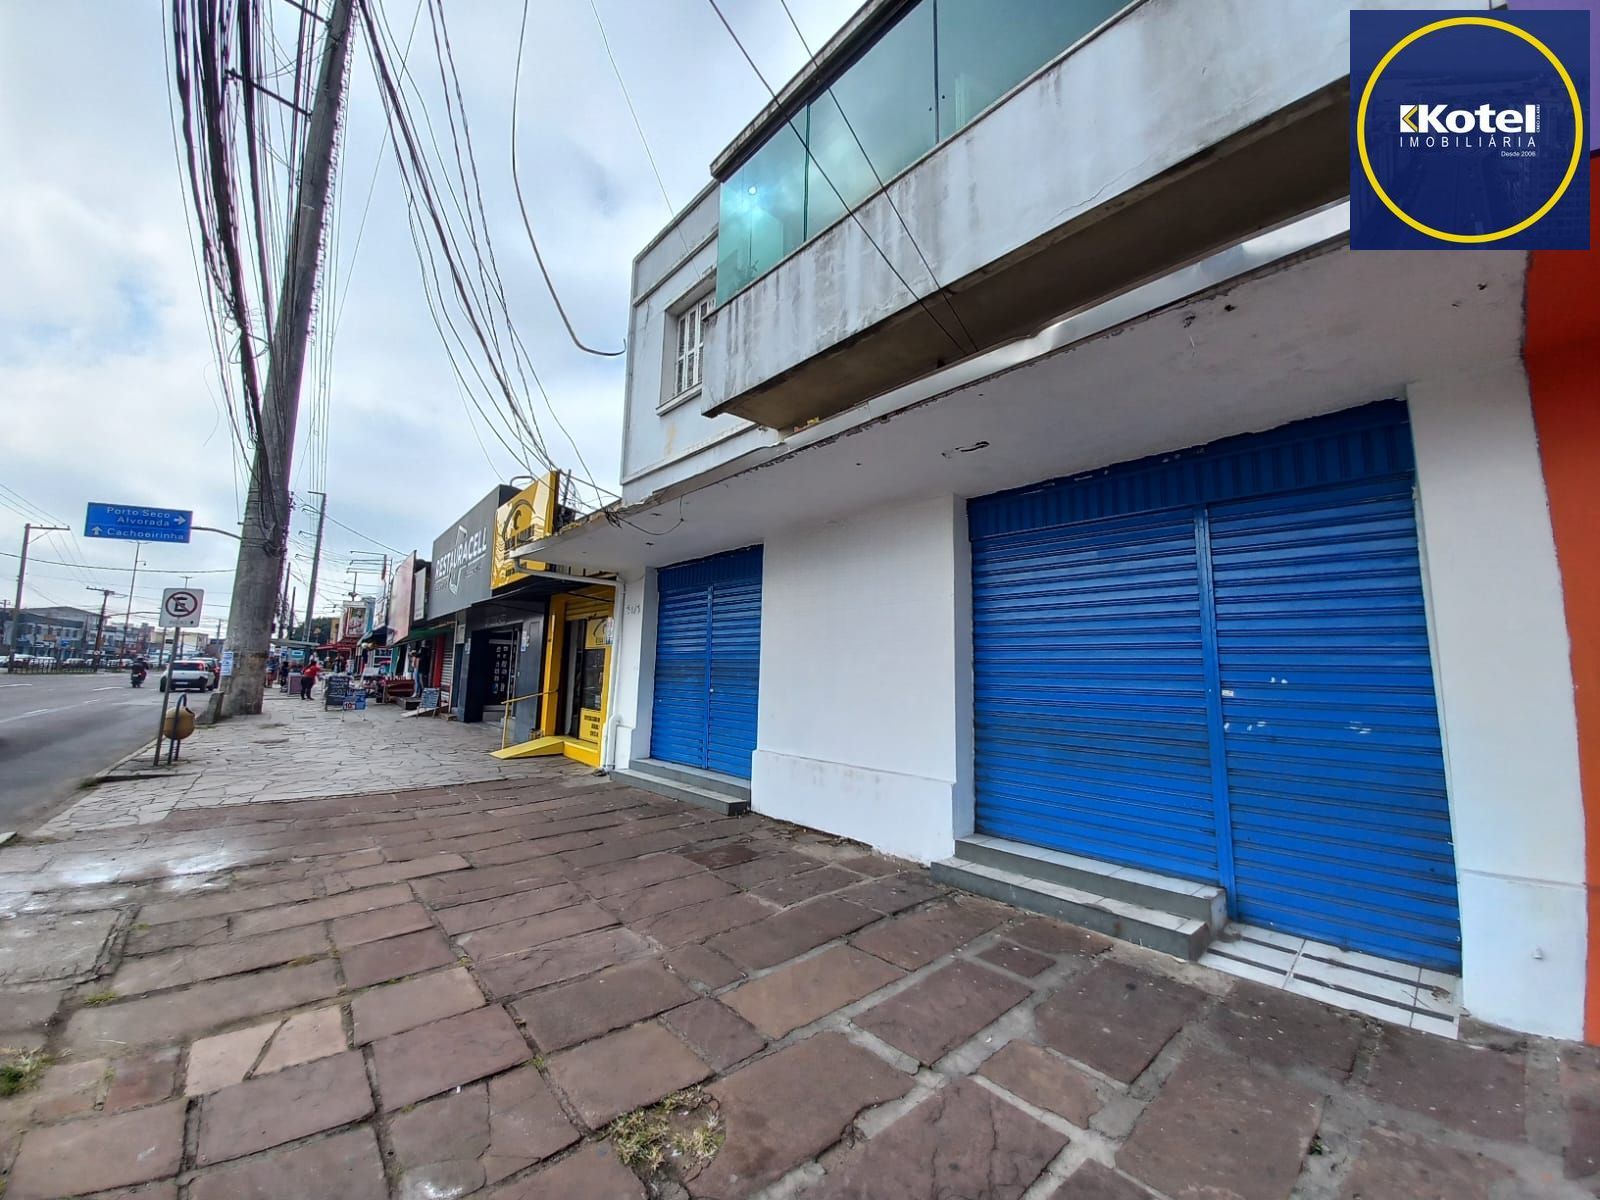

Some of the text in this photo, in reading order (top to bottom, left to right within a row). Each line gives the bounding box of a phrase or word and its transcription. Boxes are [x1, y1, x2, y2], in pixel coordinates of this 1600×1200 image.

[107, 506, 170, 519] Porto Seco
[117, 516, 170, 527] Alvorada
[107, 528, 184, 540] Cachoeirinha
[435, 527, 487, 578] RESTAURACELL
